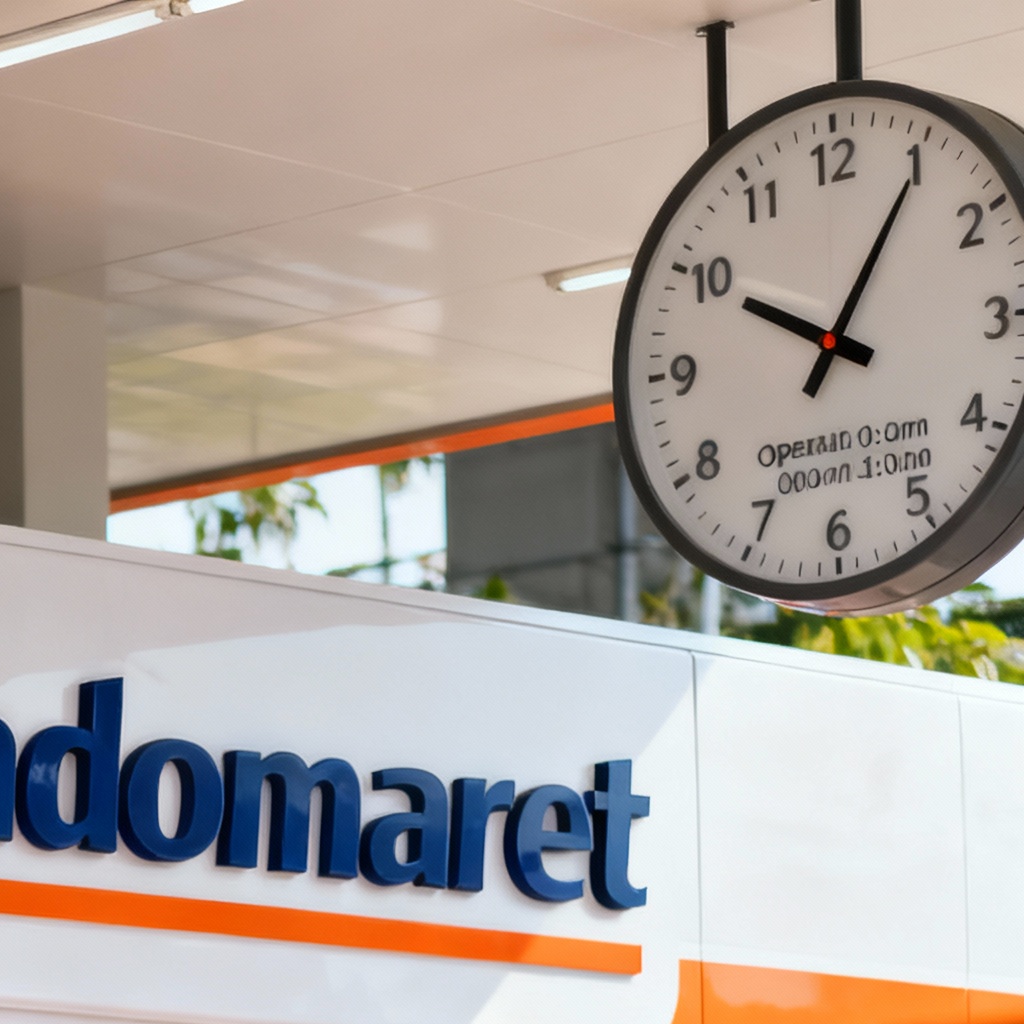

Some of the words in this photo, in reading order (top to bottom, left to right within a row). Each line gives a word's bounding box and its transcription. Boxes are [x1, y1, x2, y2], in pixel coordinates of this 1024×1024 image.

[810, 138, 856, 186] 12
[906, 143, 921, 186] 1
[743, 180, 777, 223] 11
[956, 202, 985, 249] 2
[691, 256, 733, 303] 10
[983, 295, 1010, 339] 3
[670, 354, 697, 396] 9
[960, 392, 987, 432] 4
[695, 440, 720, 480] 8
[905, 475, 930, 517] 5
[752, 499, 776, 541] 7
[826, 509, 851, 551] 6
